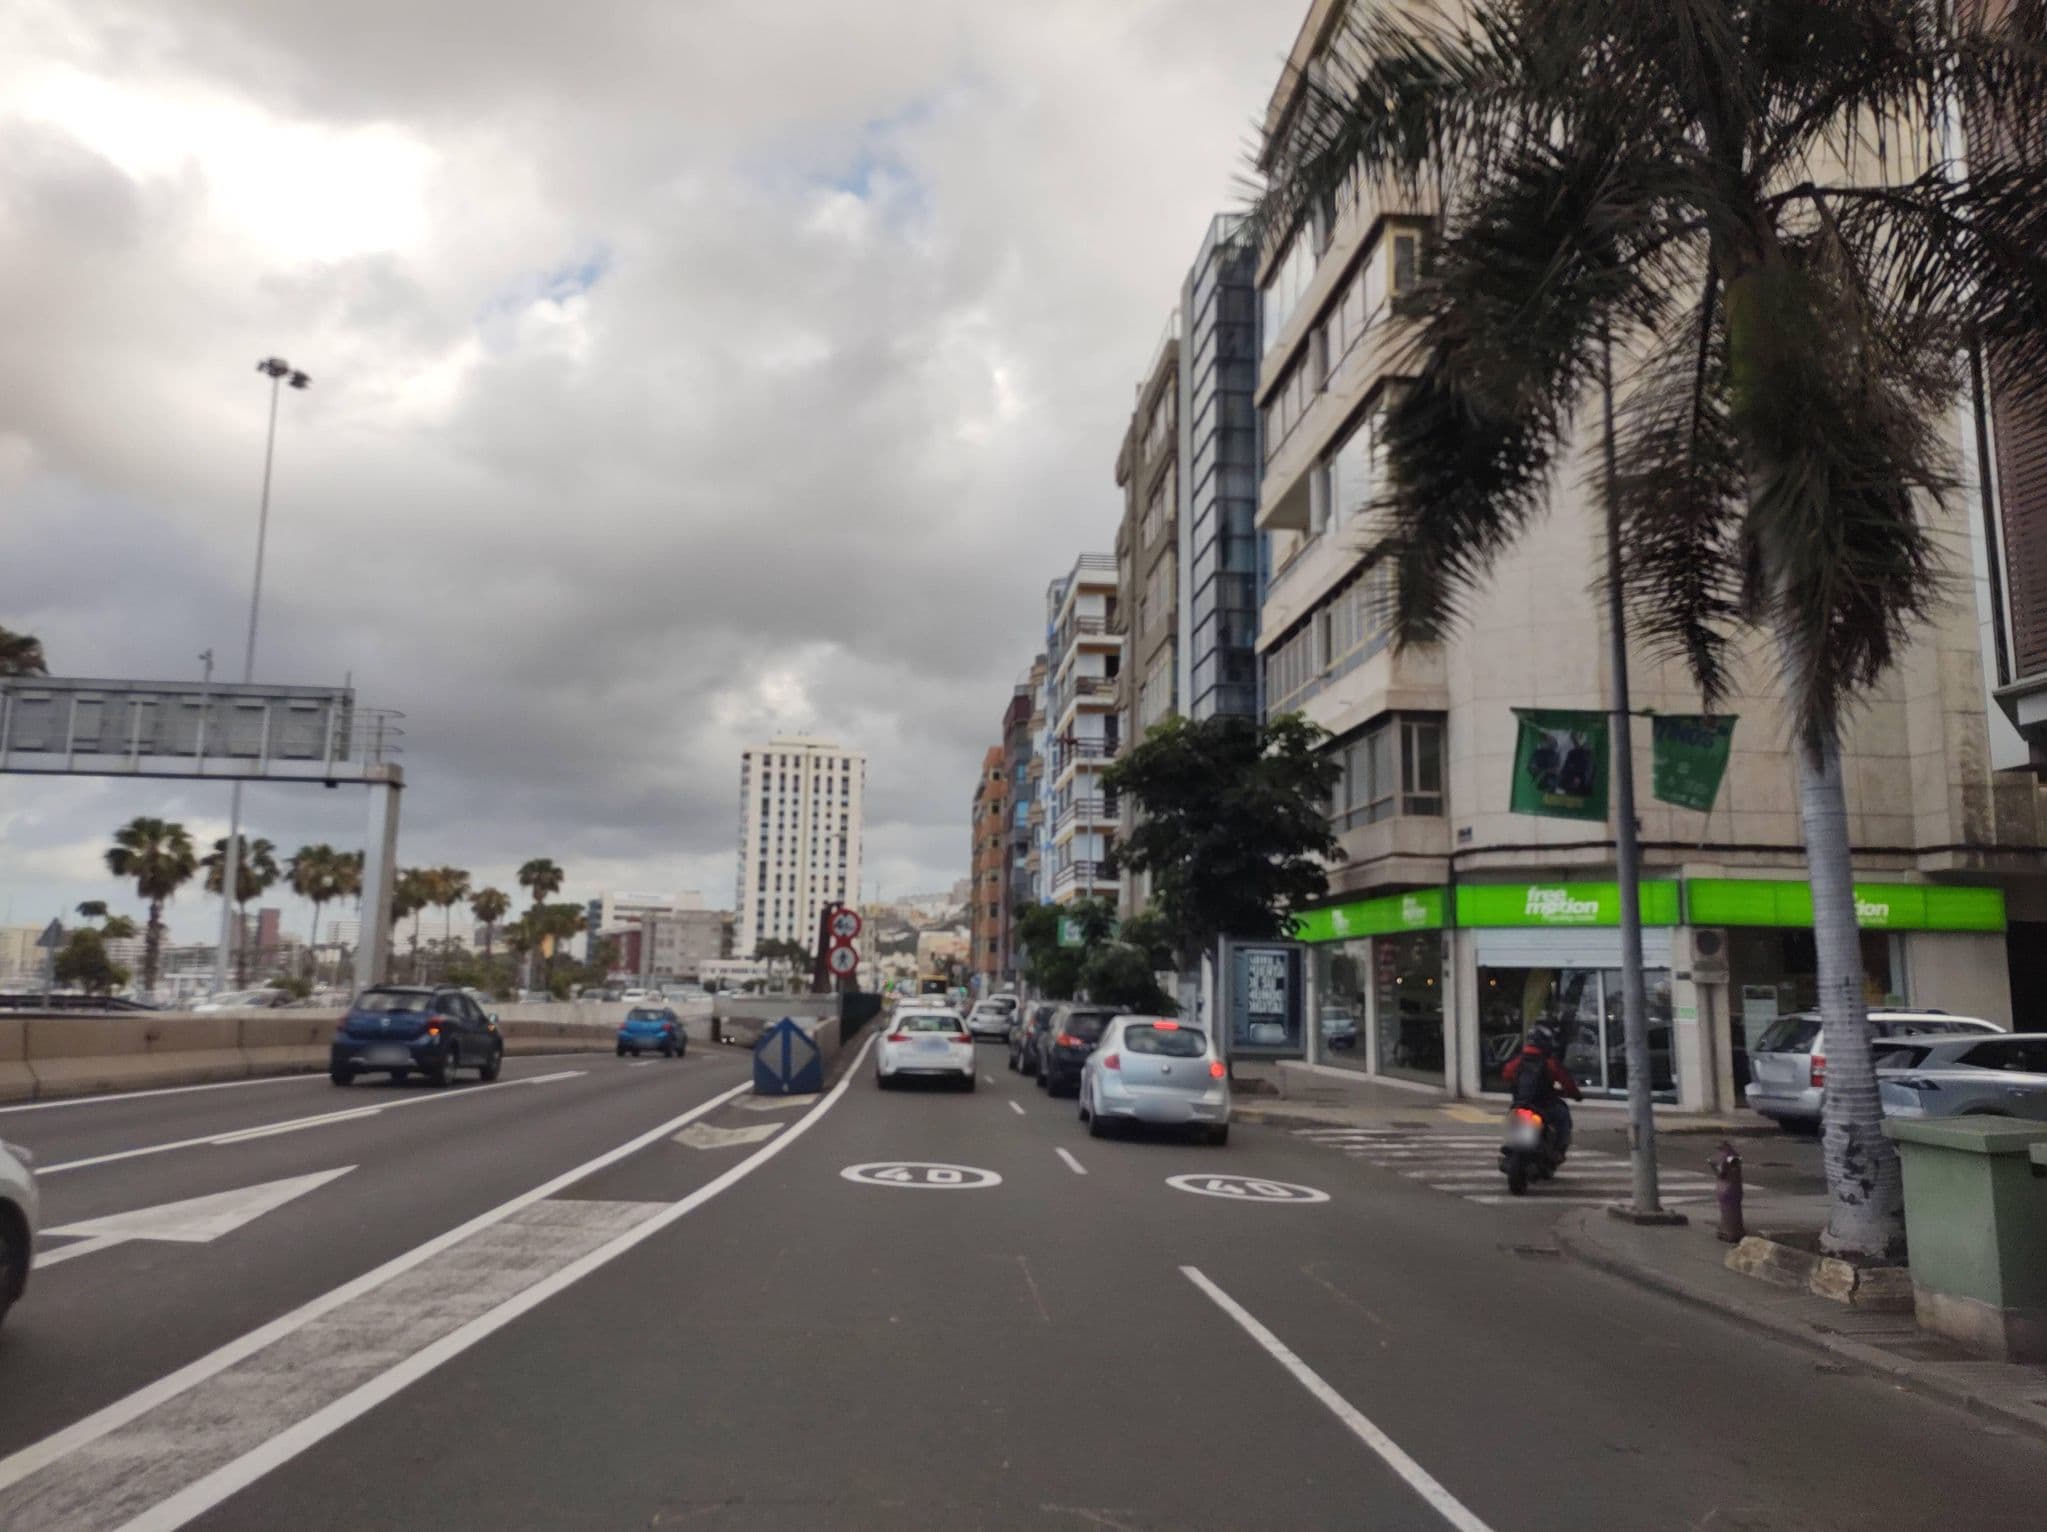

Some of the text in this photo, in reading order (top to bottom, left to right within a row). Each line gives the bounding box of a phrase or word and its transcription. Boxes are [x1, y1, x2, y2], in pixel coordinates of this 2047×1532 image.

[1526, 886, 1567, 903] free
[1525, 897, 1599, 915] motion
[874, 1167, 962, 1183] 40
[1206, 1179, 1293, 1197] 40
